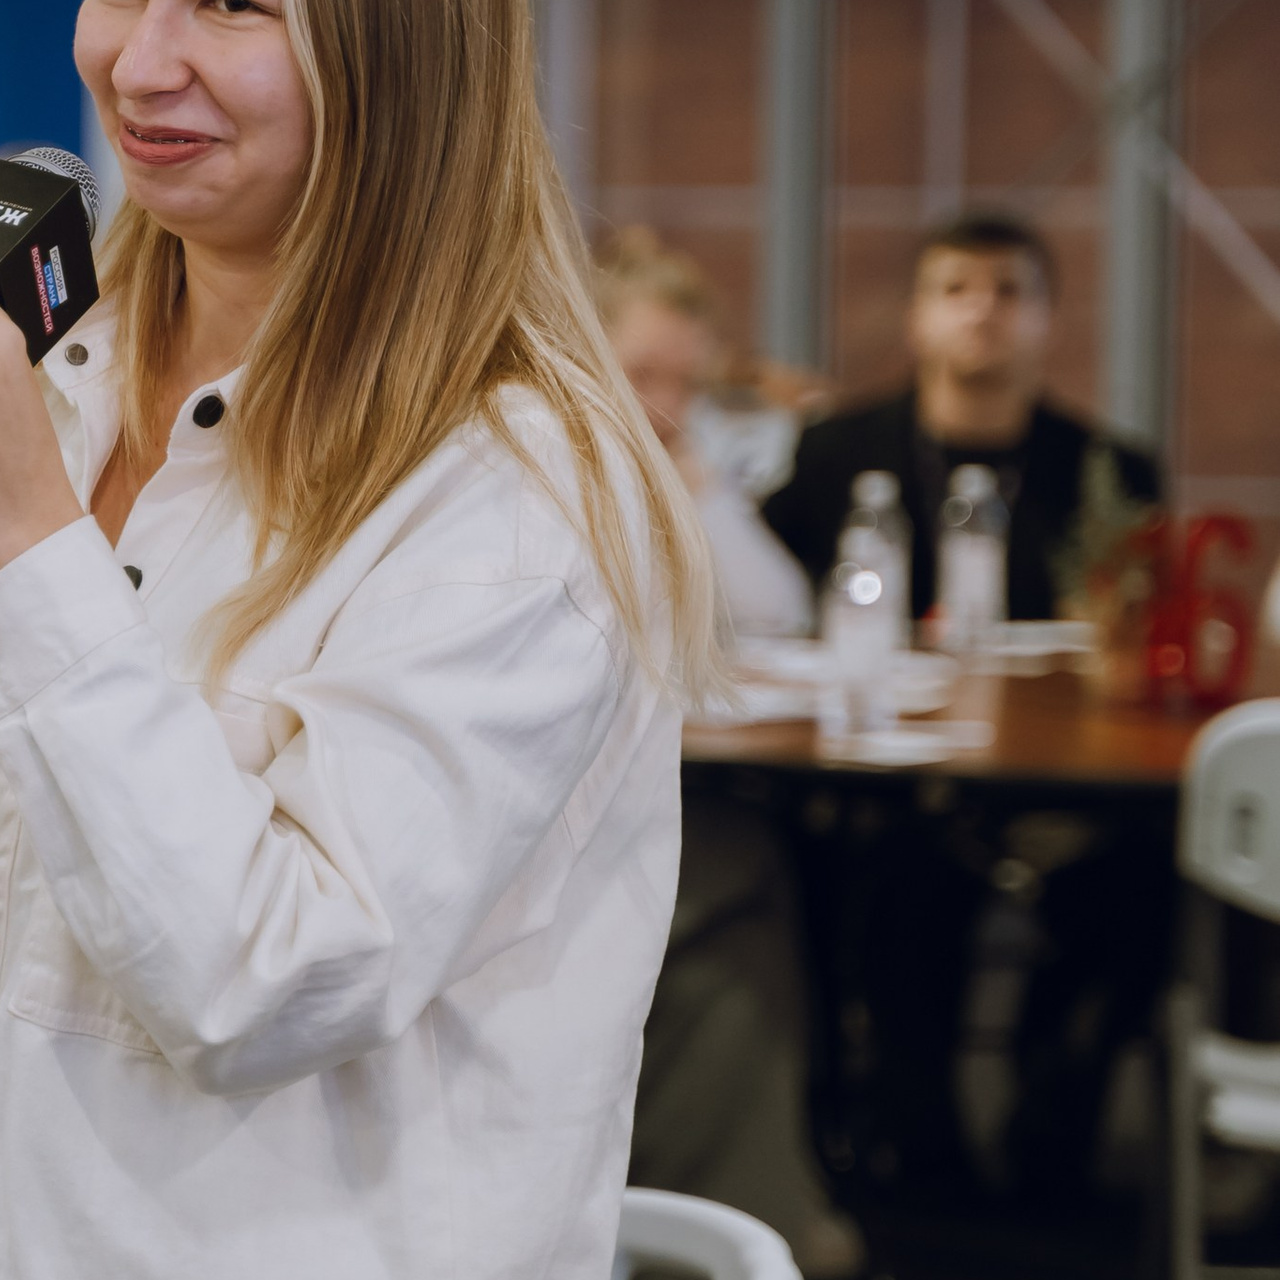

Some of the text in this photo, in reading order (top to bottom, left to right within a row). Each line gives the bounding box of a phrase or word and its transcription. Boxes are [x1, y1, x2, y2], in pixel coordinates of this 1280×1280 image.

[31, 246, 54, 333] ВОЗМОЖНОСТЕЙ
[43, 264, 57, 307] СТРАНА
[51, 249, 64, 291] РОССИЯ
